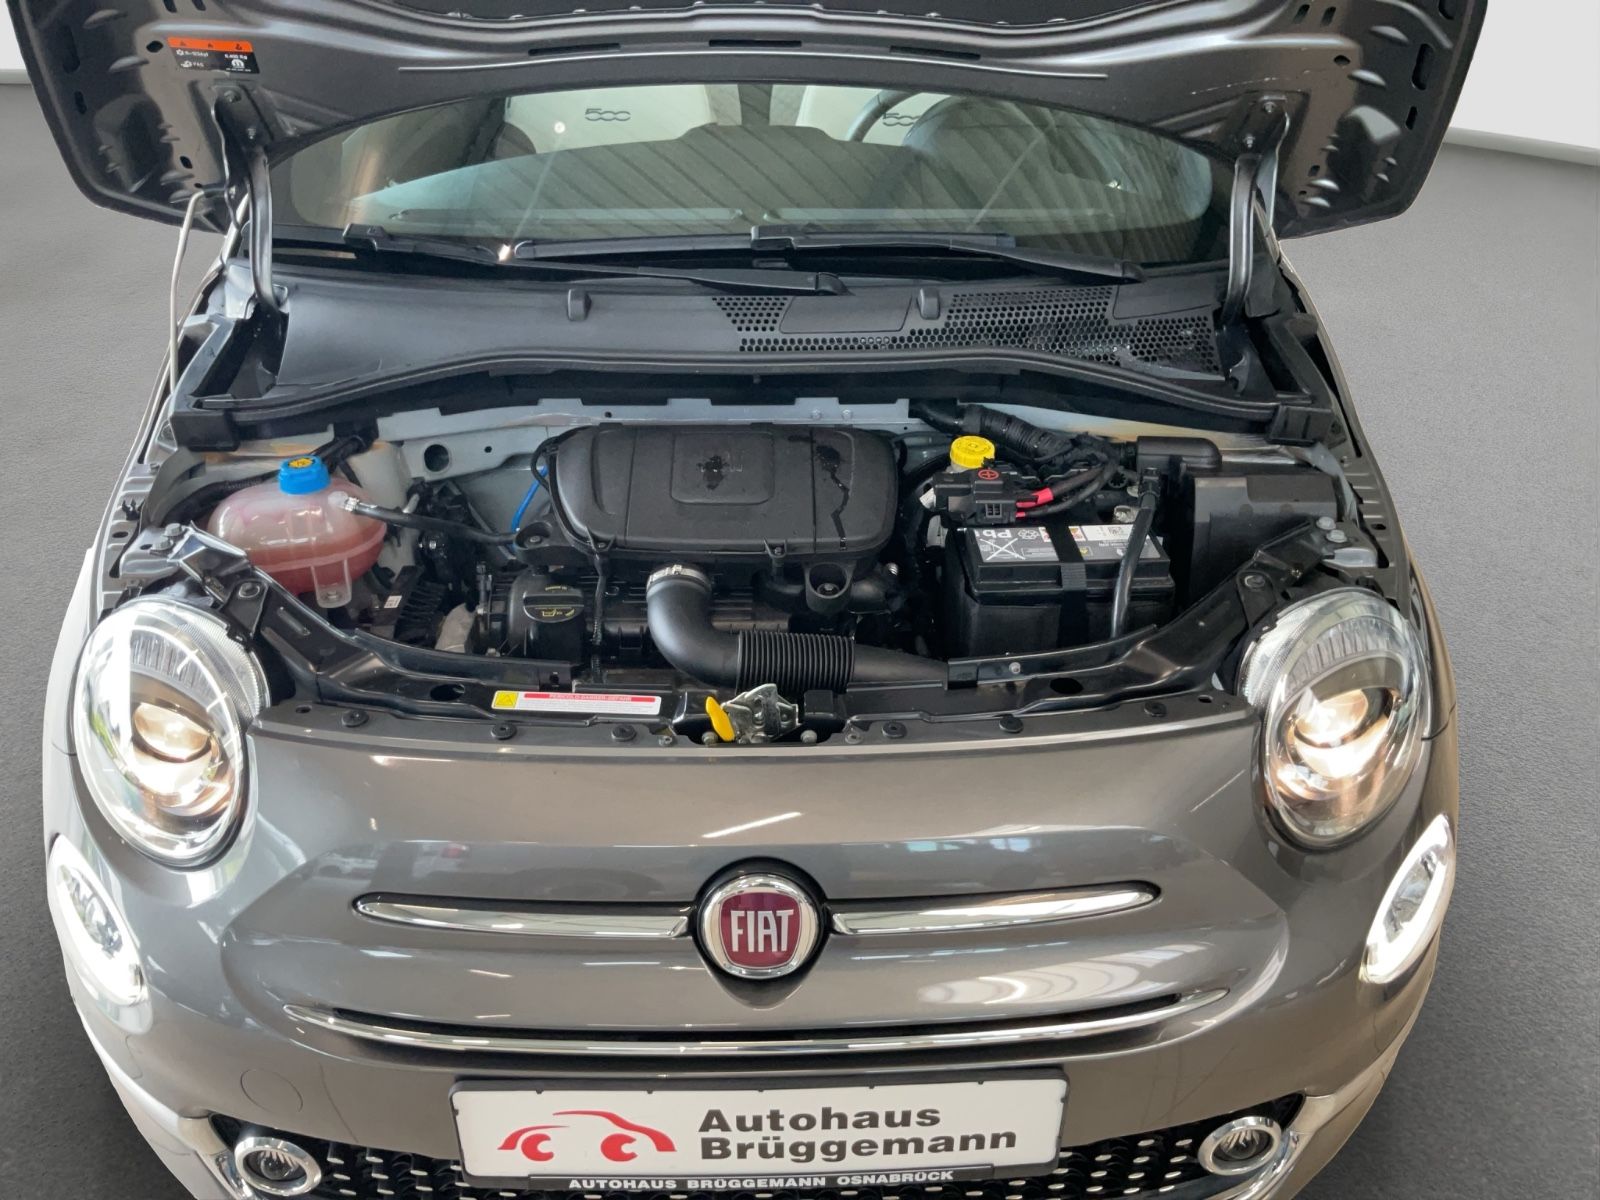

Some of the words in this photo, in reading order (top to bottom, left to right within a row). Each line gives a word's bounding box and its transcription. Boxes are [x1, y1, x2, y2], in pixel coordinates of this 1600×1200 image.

[585, 108, 631, 121] 500
[730, 909, 794, 952] FIAT
[698, 1106, 941, 1132] Autohaus
[701, 1130, 1017, 1163] Brüggemann
[569, 1179, 677, 1189] AUTOHAUS
[687, 1176, 826, 1189] BRÜGGEMANN
[837, 1171, 953, 1185] OSNABRÜCK
